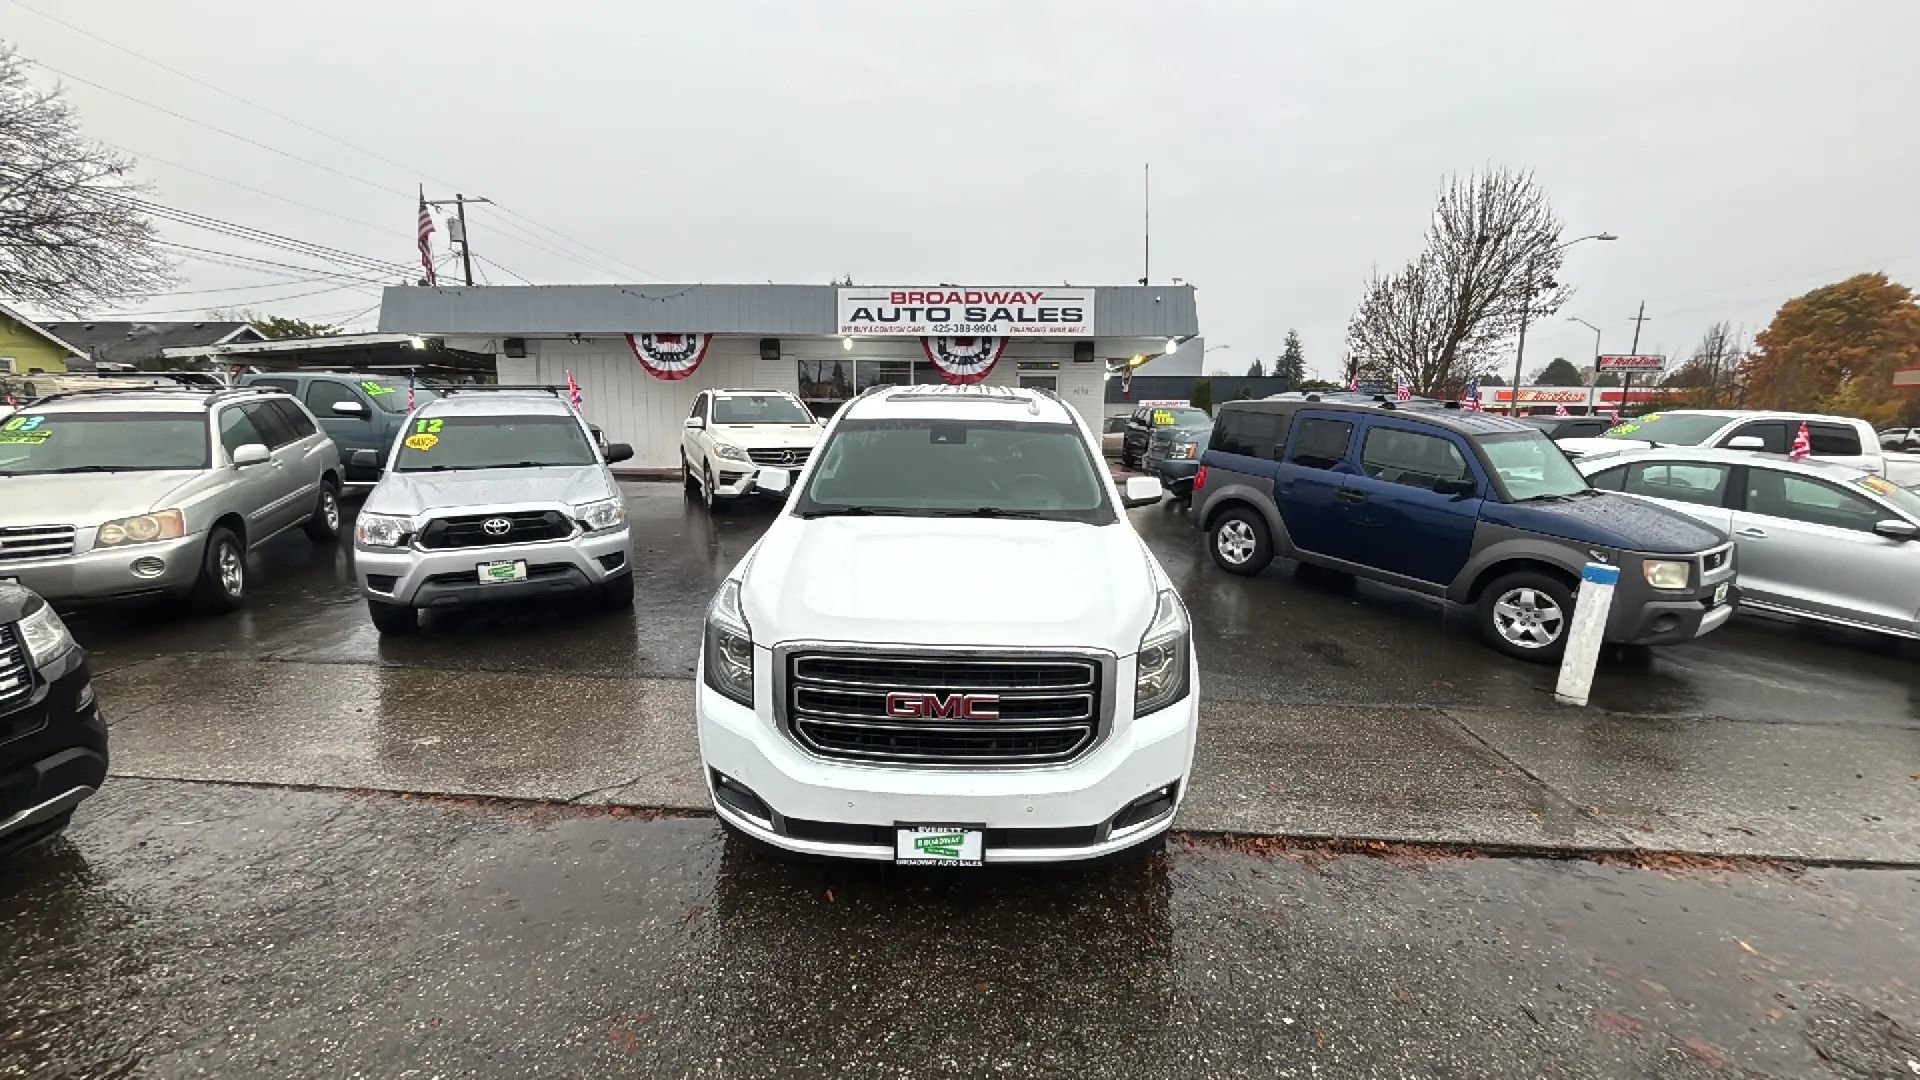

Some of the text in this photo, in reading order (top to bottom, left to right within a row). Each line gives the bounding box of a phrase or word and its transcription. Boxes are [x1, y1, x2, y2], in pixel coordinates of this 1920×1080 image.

[890, 291, 1044, 305] BROADWAY
[850, 307, 1083, 323] AUTO SALES
[841, 325, 852, 333] WE
[853, 325, 867, 333] BUY
[874, 325, 905, 333] CONSIGN
[906, 325, 925, 333] CARS
[932, 323, 998, 333] 425-388-9904
[5, 416, 45, 431] 03
[416, 418, 443, 433] 12
[886, 692, 1000, 720] GMC
[917, 836, 961, 847] BROADWAY
